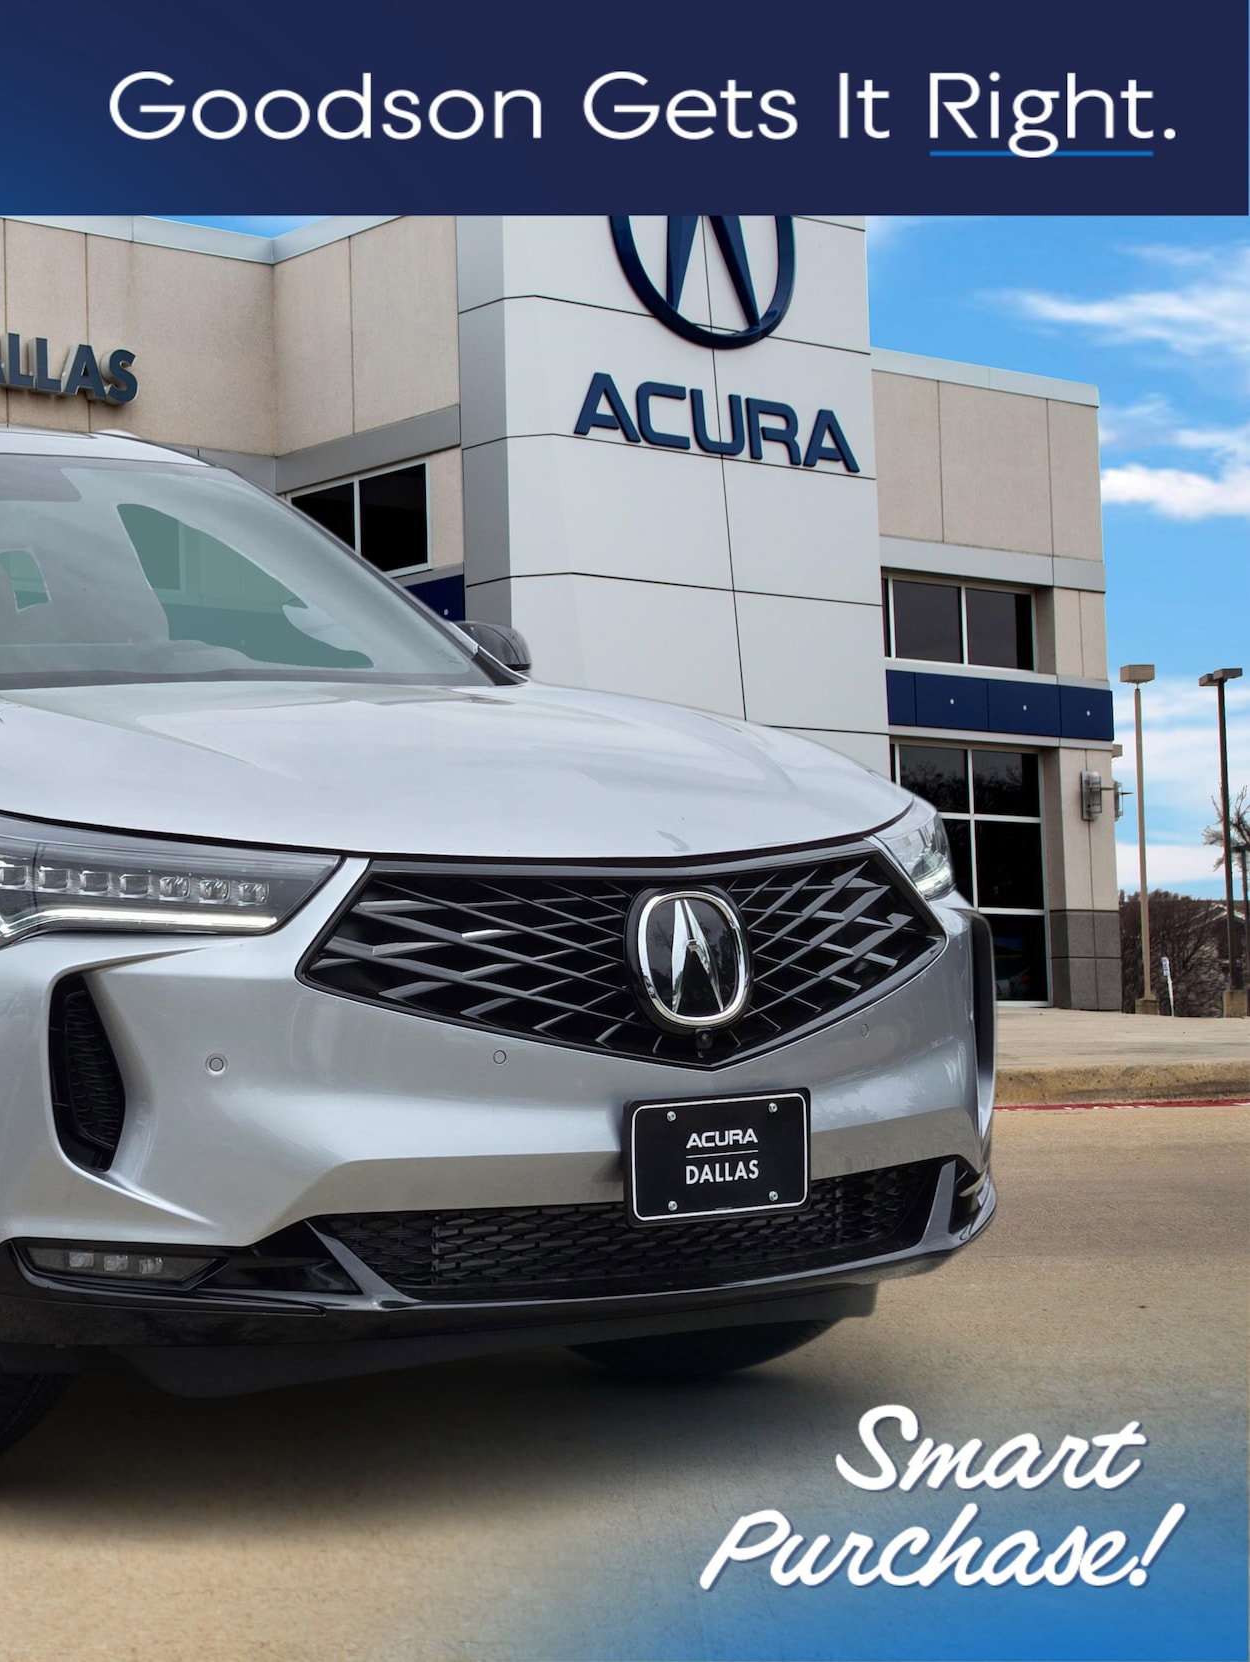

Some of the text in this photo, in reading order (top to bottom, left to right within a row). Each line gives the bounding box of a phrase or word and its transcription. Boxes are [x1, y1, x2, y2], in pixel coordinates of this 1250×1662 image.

[573, 372, 860, 473] ACURA
[686, 1128, 759, 1149] ACURA
[685, 1159, 759, 1185] DALLAS
